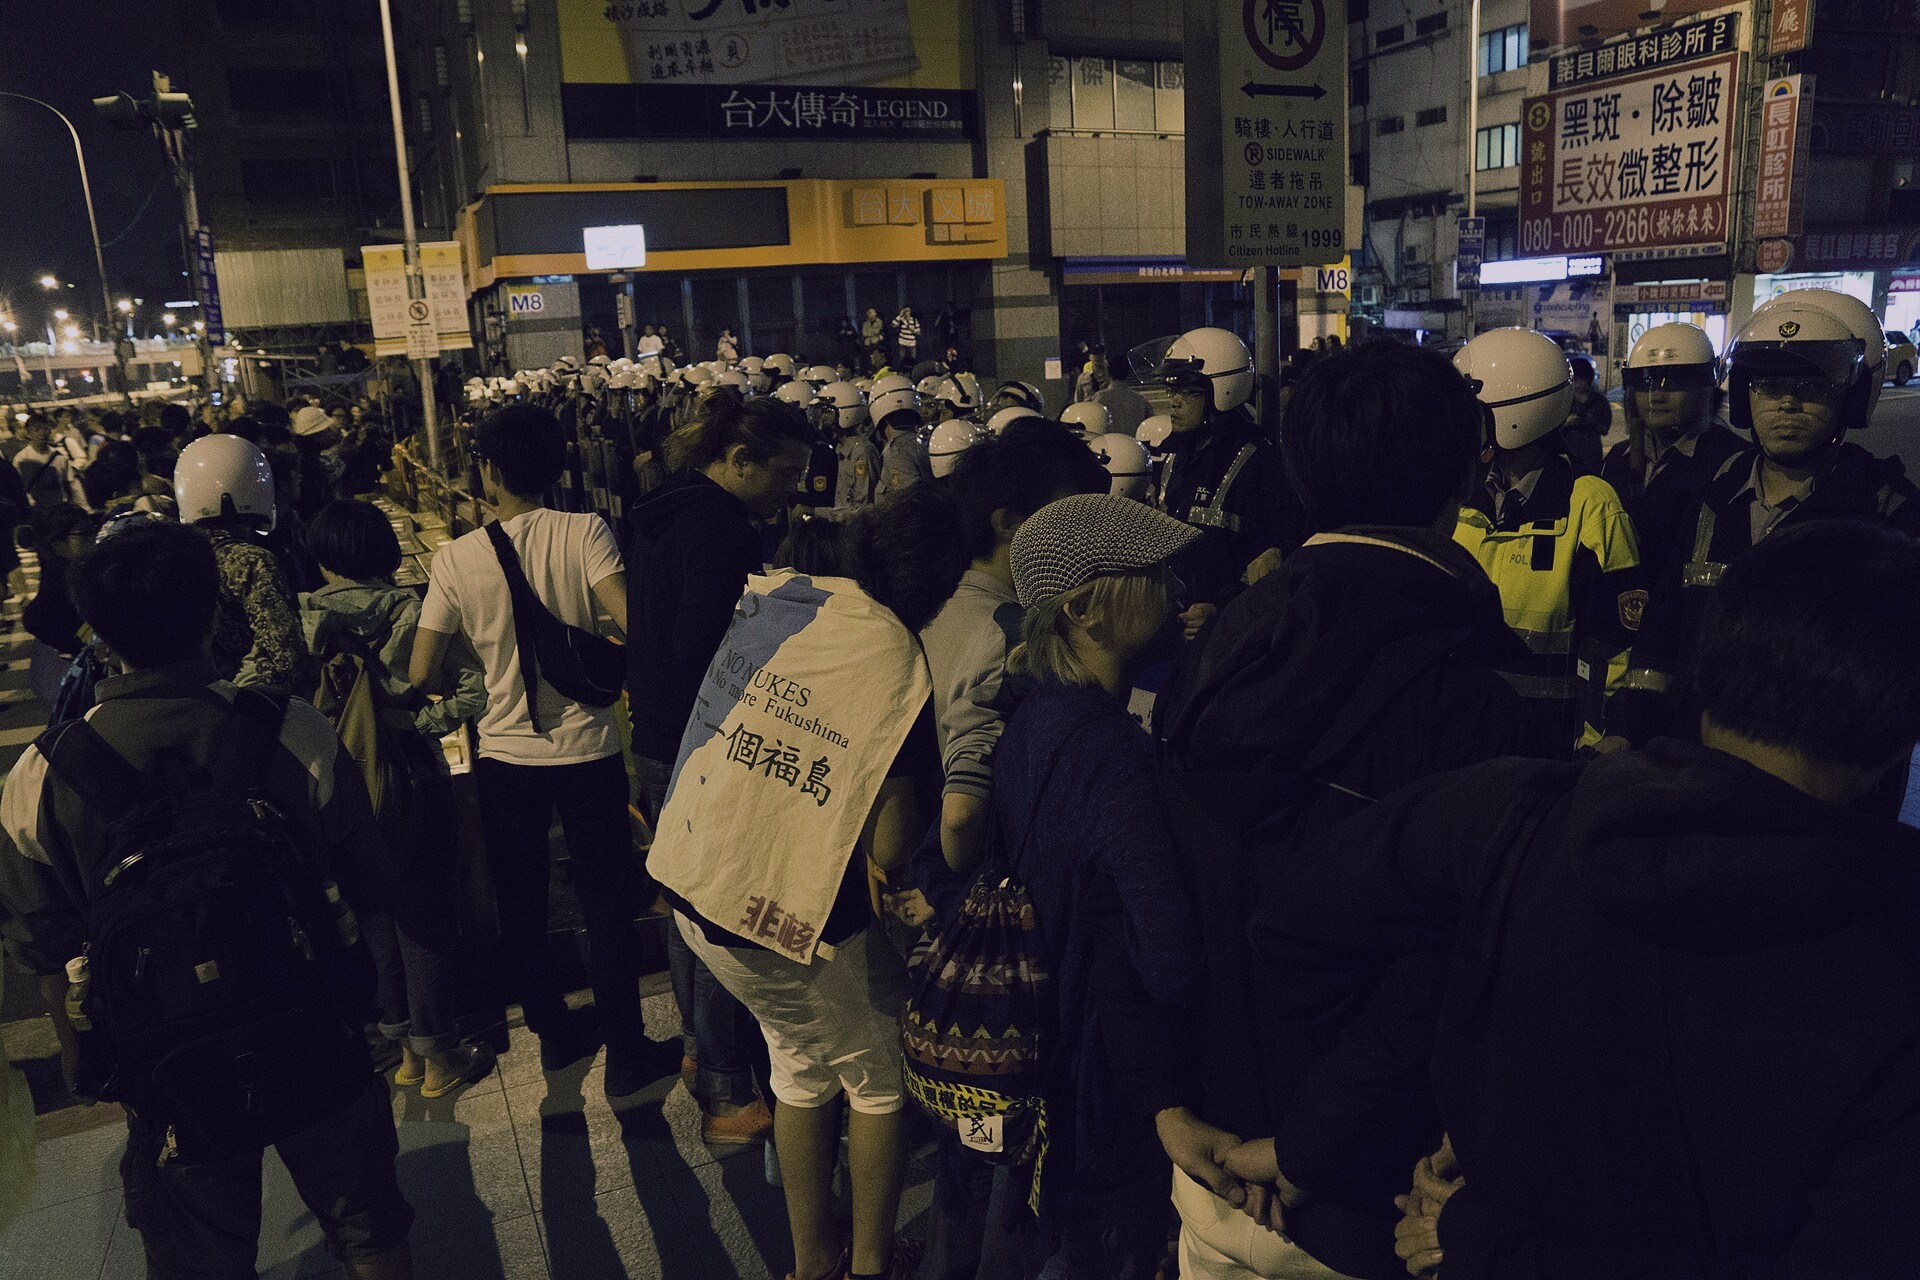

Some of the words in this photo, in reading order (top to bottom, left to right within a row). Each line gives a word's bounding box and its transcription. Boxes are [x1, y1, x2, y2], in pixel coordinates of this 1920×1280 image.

[1556, 24, 1706, 83] 諾貝爾眼科診所
[720, 90, 860, 128] 台大傳奇
[863, 99, 948, 118] LEGEND
[1267, 148, 1326, 162] SIDEWALK
[1763, 100, 1791, 200] 長虹診所
[1249, 169, 1323, 190] 違者拖吊
[1557, 136, 1718, 206] 長效微整形
[1239, 196, 1298, 209] TOW-AWAY
[1303, 197, 1333, 209] ZONE
[1229, 245, 1263, 257] Citizen
[1266, 245, 1300, 257] Hotline
[1230, 224, 1298, 239] 市民熱線
[1302, 229, 1342, 248] 1999
[1317, 270, 1348, 290] M8
[512, 294, 542, 311] M8
[721, 649, 745, 674] NO
[741, 662, 811, 707] NUKES
[712, 668, 727, 689] No
[728, 684, 757, 707] more
[764, 697, 849, 749] Fukushima
[740, 895, 815, 960] 非核
